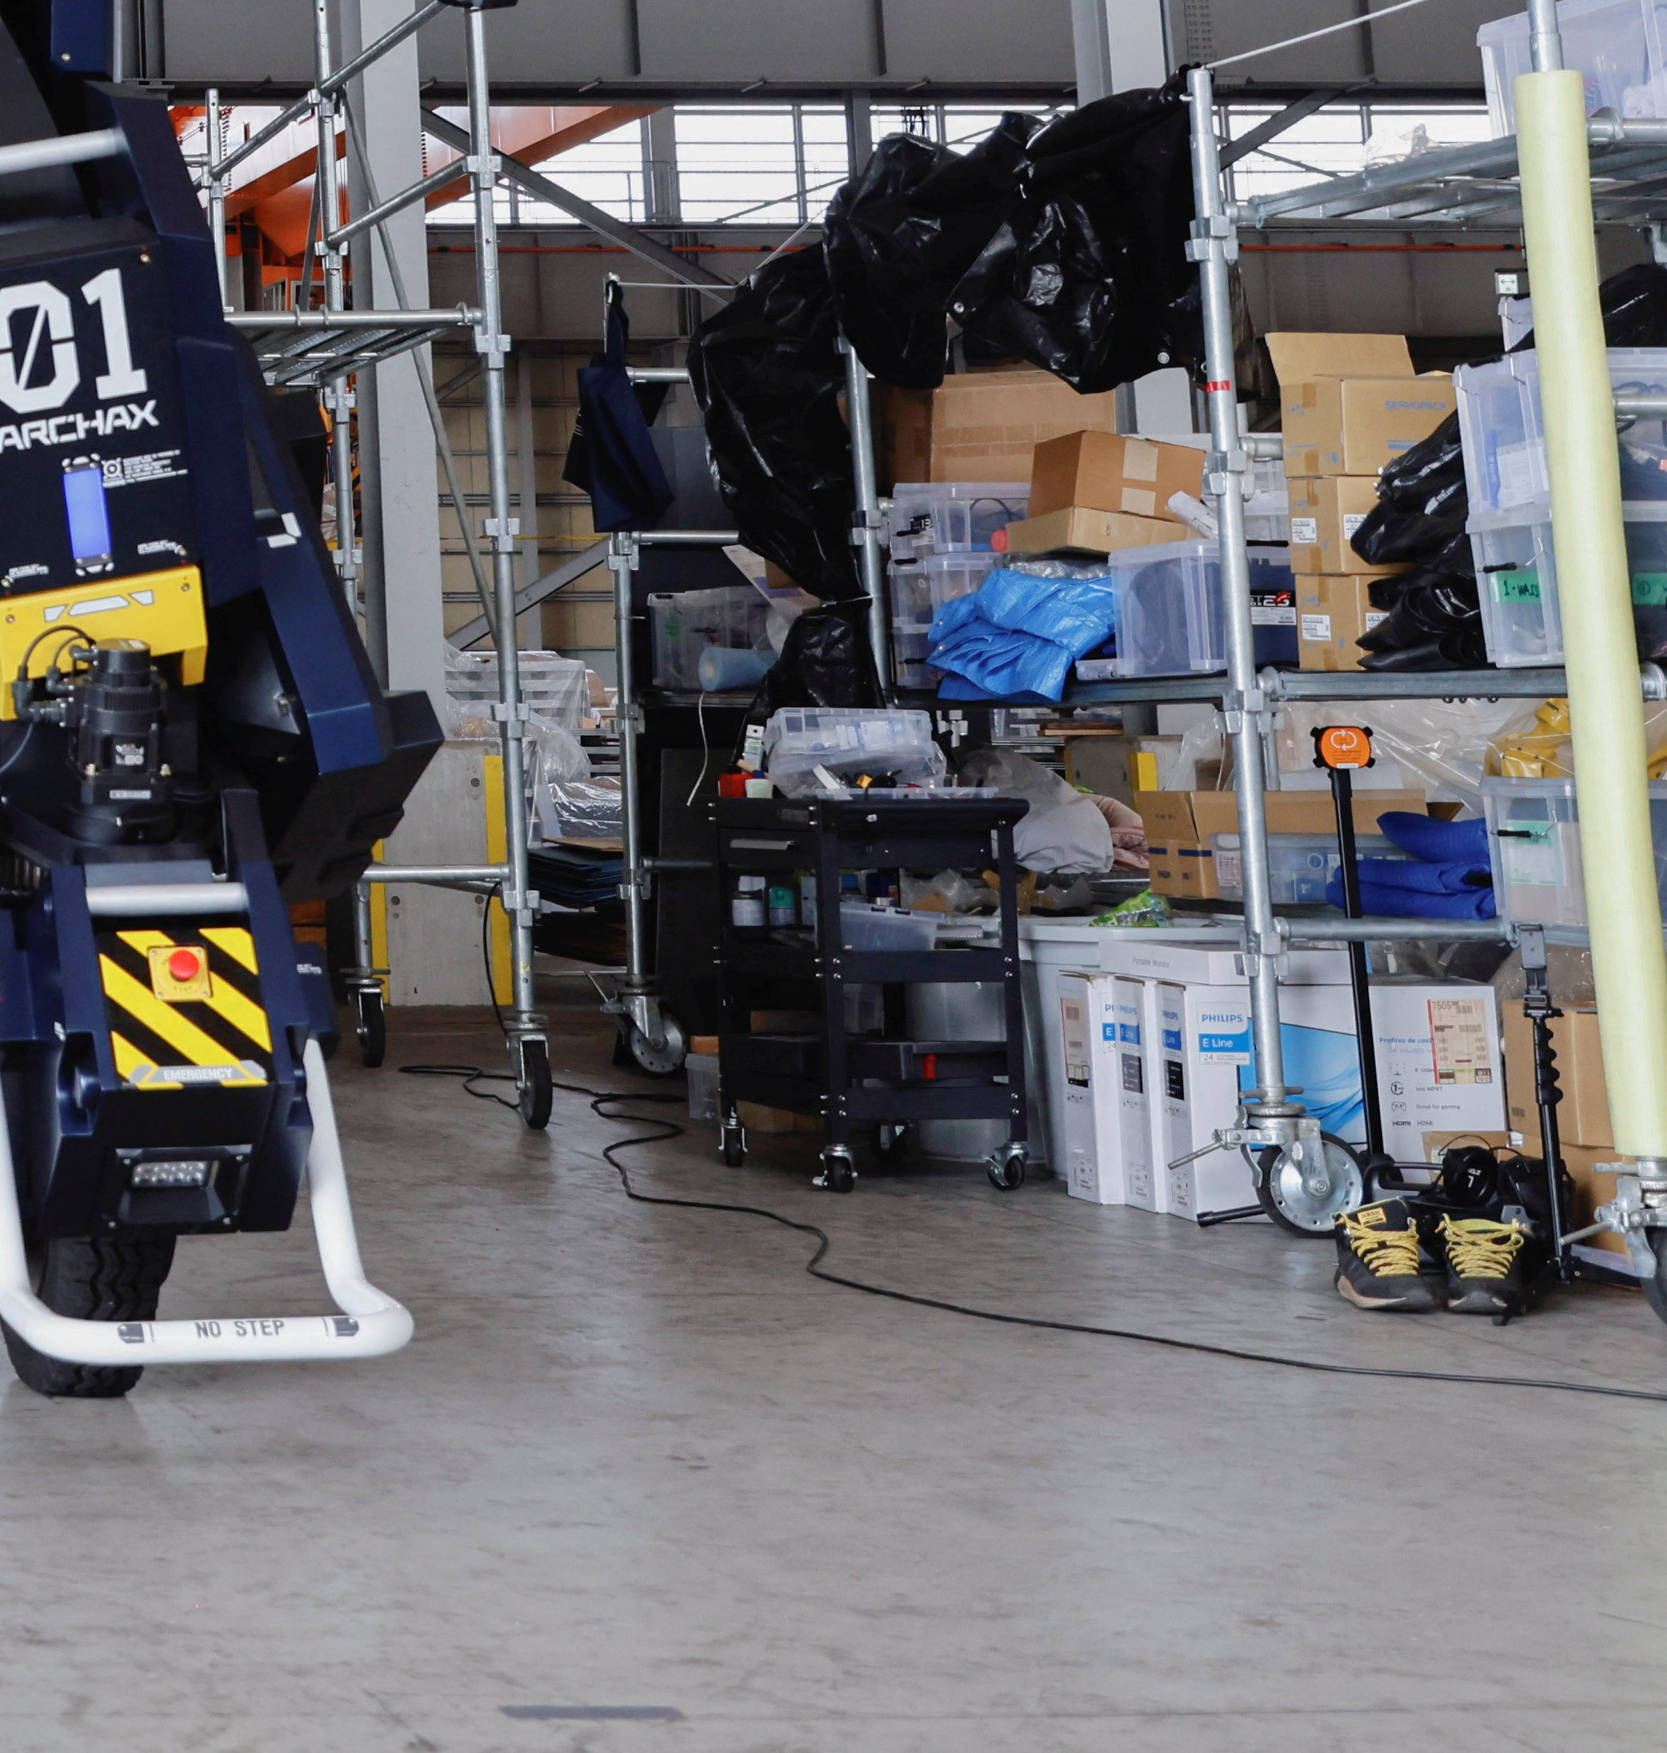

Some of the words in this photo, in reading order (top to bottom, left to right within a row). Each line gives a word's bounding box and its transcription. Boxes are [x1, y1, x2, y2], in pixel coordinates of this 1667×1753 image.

[1385, 400, 1447, 411] SERVOPACK
[1201, 1013, 1243, 1022] PHILIPS
[1202, 1038, 1208, 1047] E
[1212, 1037, 1233, 1048] Line
[1203, 1053, 1214, 1062] 24
[163, 1067, 233, 1080] EMERGENCY
[194, 1320, 222, 1339] NO
[233, 1319, 285, 1337] STEP
